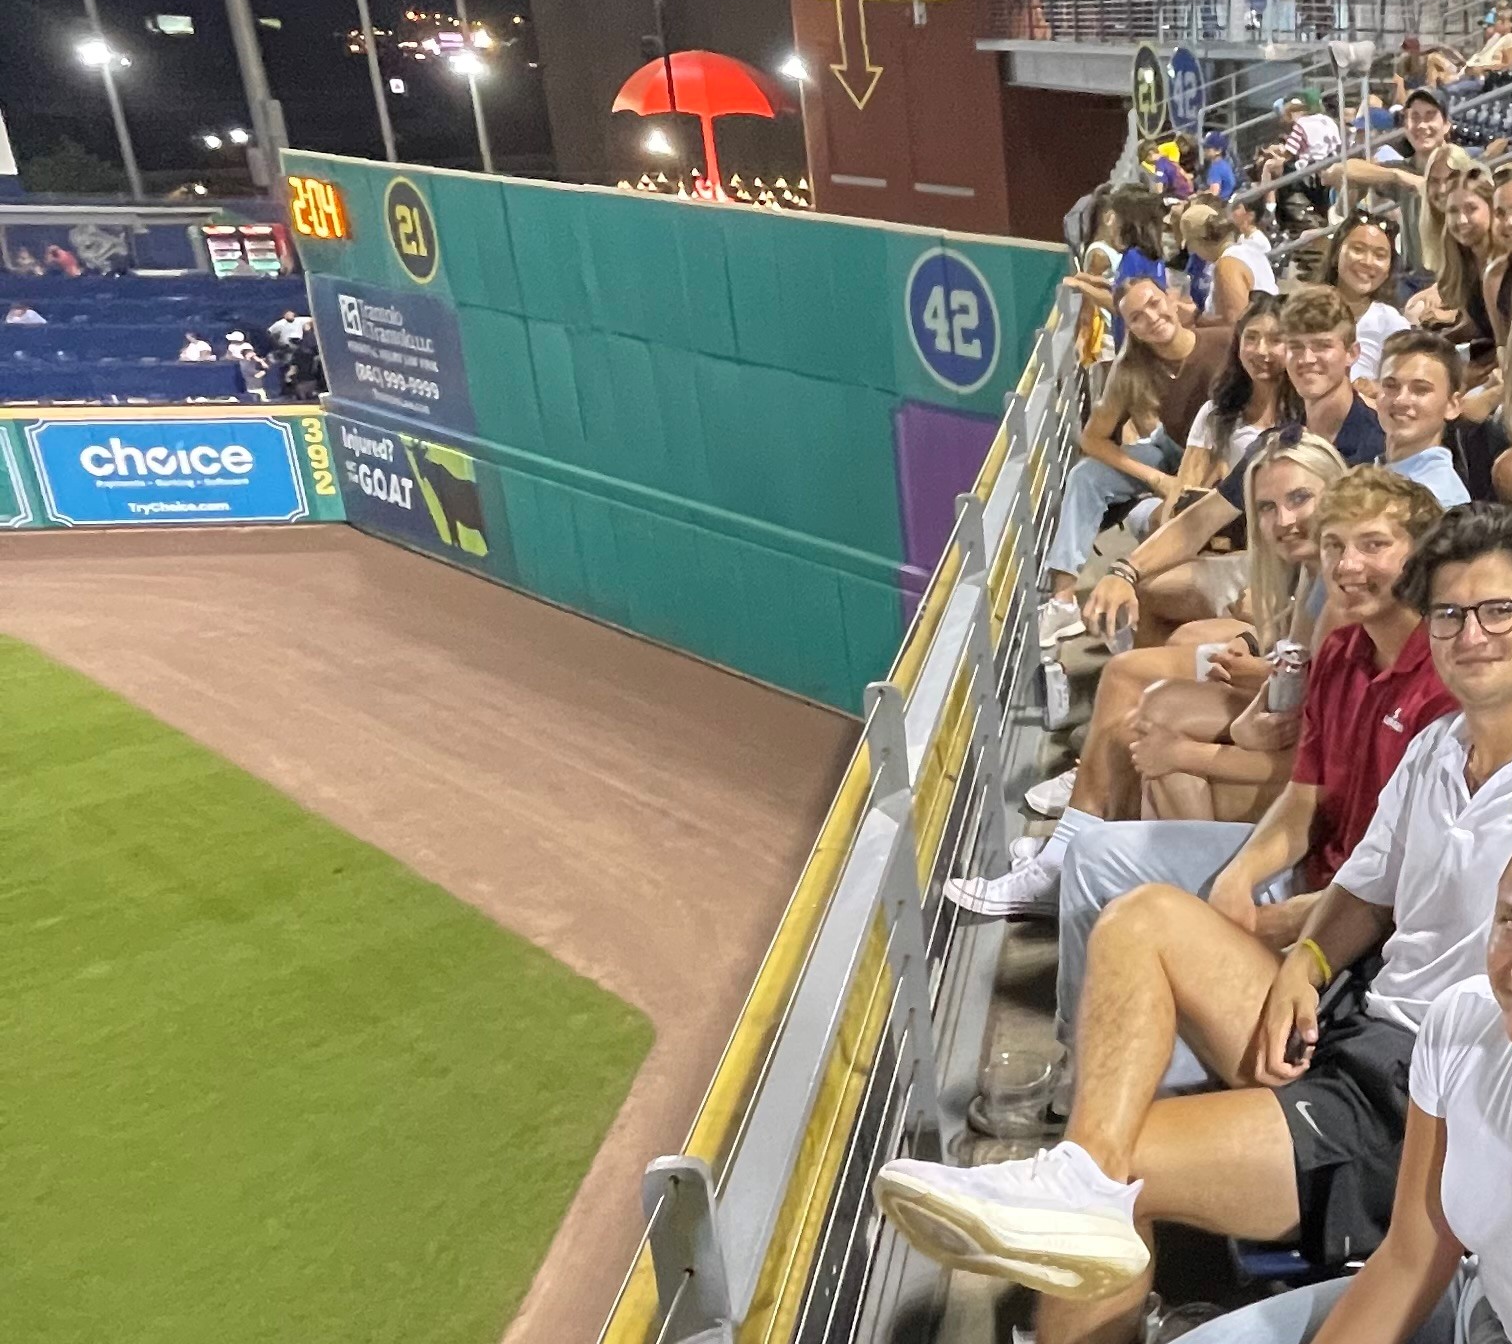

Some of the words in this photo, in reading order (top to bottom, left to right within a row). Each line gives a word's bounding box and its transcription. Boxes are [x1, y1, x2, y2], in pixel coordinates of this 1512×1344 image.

[1138, 67, 1158, 113] 21
[1172, 70, 1198, 118] 42
[394, 205, 428, 256] 21
[922, 285, 983, 359] 42
[80, 437, 254, 477] choice
